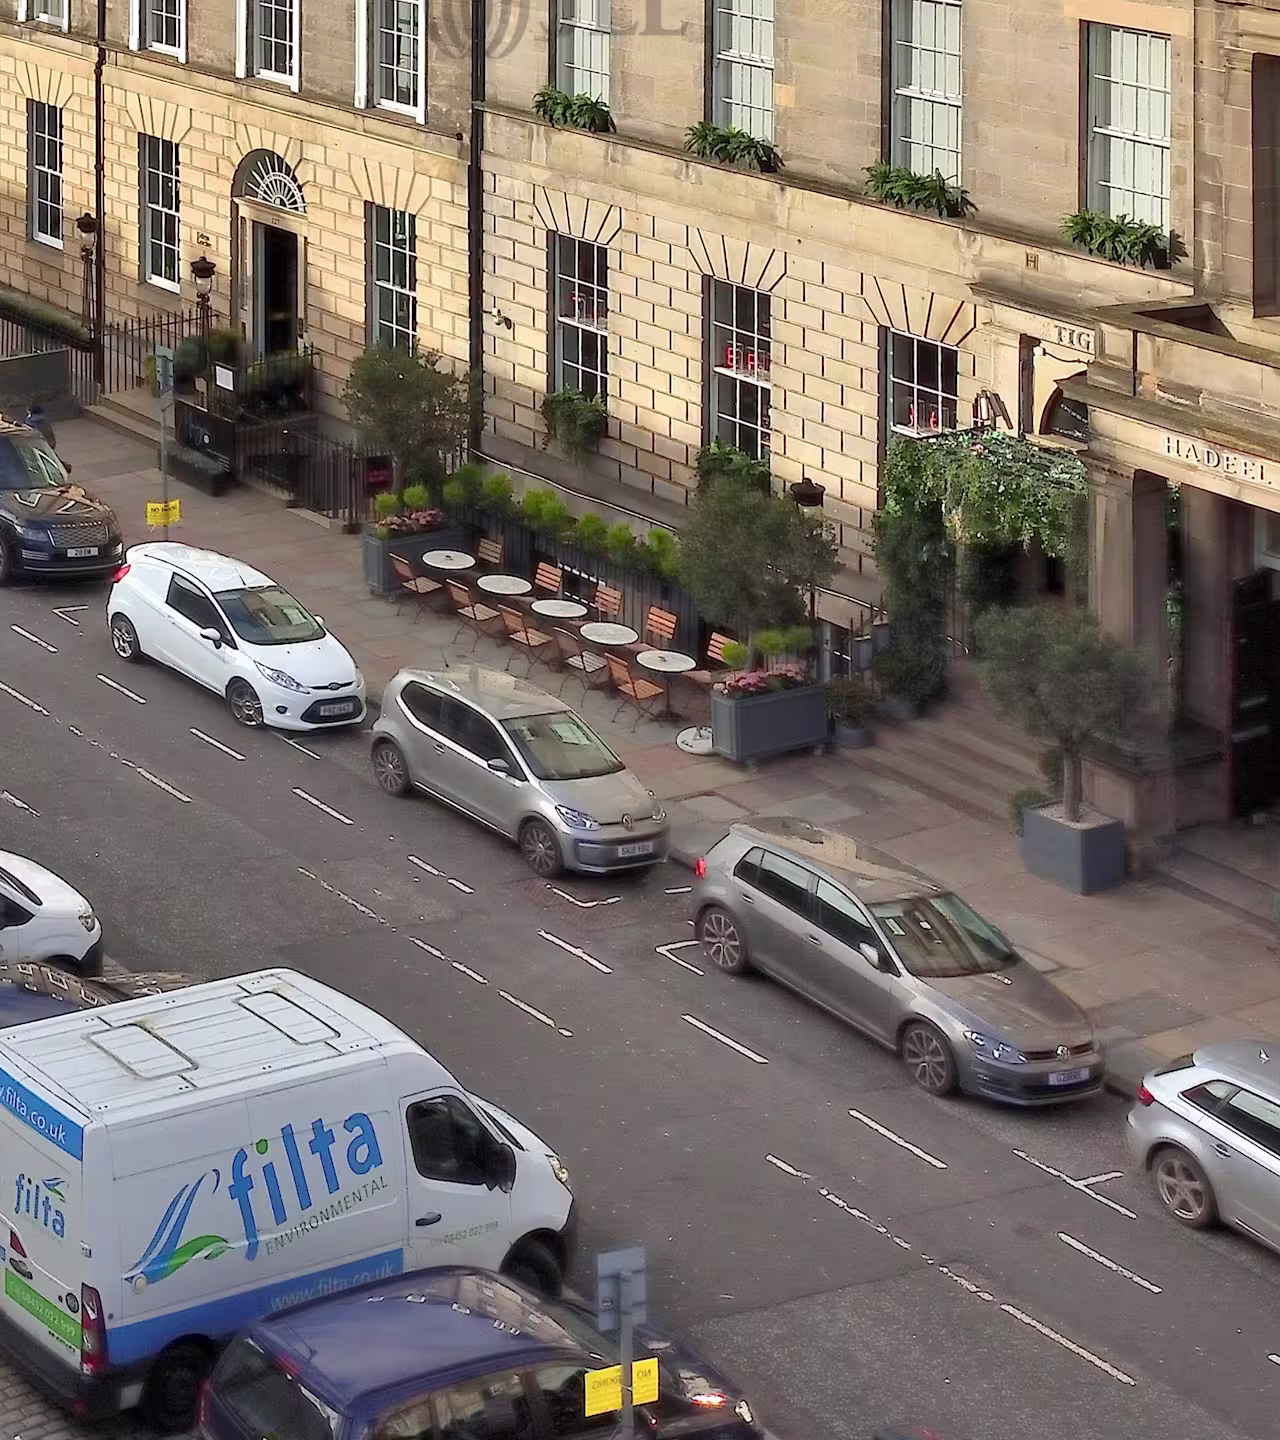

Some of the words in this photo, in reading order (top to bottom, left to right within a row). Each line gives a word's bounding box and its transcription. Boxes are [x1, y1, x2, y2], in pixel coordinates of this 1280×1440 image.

[1054, 325, 1094, 353] TIG
[1164, 436, 1272, 485] HADEEL
[14, 1173, 66, 1240] filta
[228, 1112, 383, 1261] filta
[265, 1175, 389, 1256] ENVIRONMENTAL
[269, 1259, 396, 1313] www.filta.co.uk
